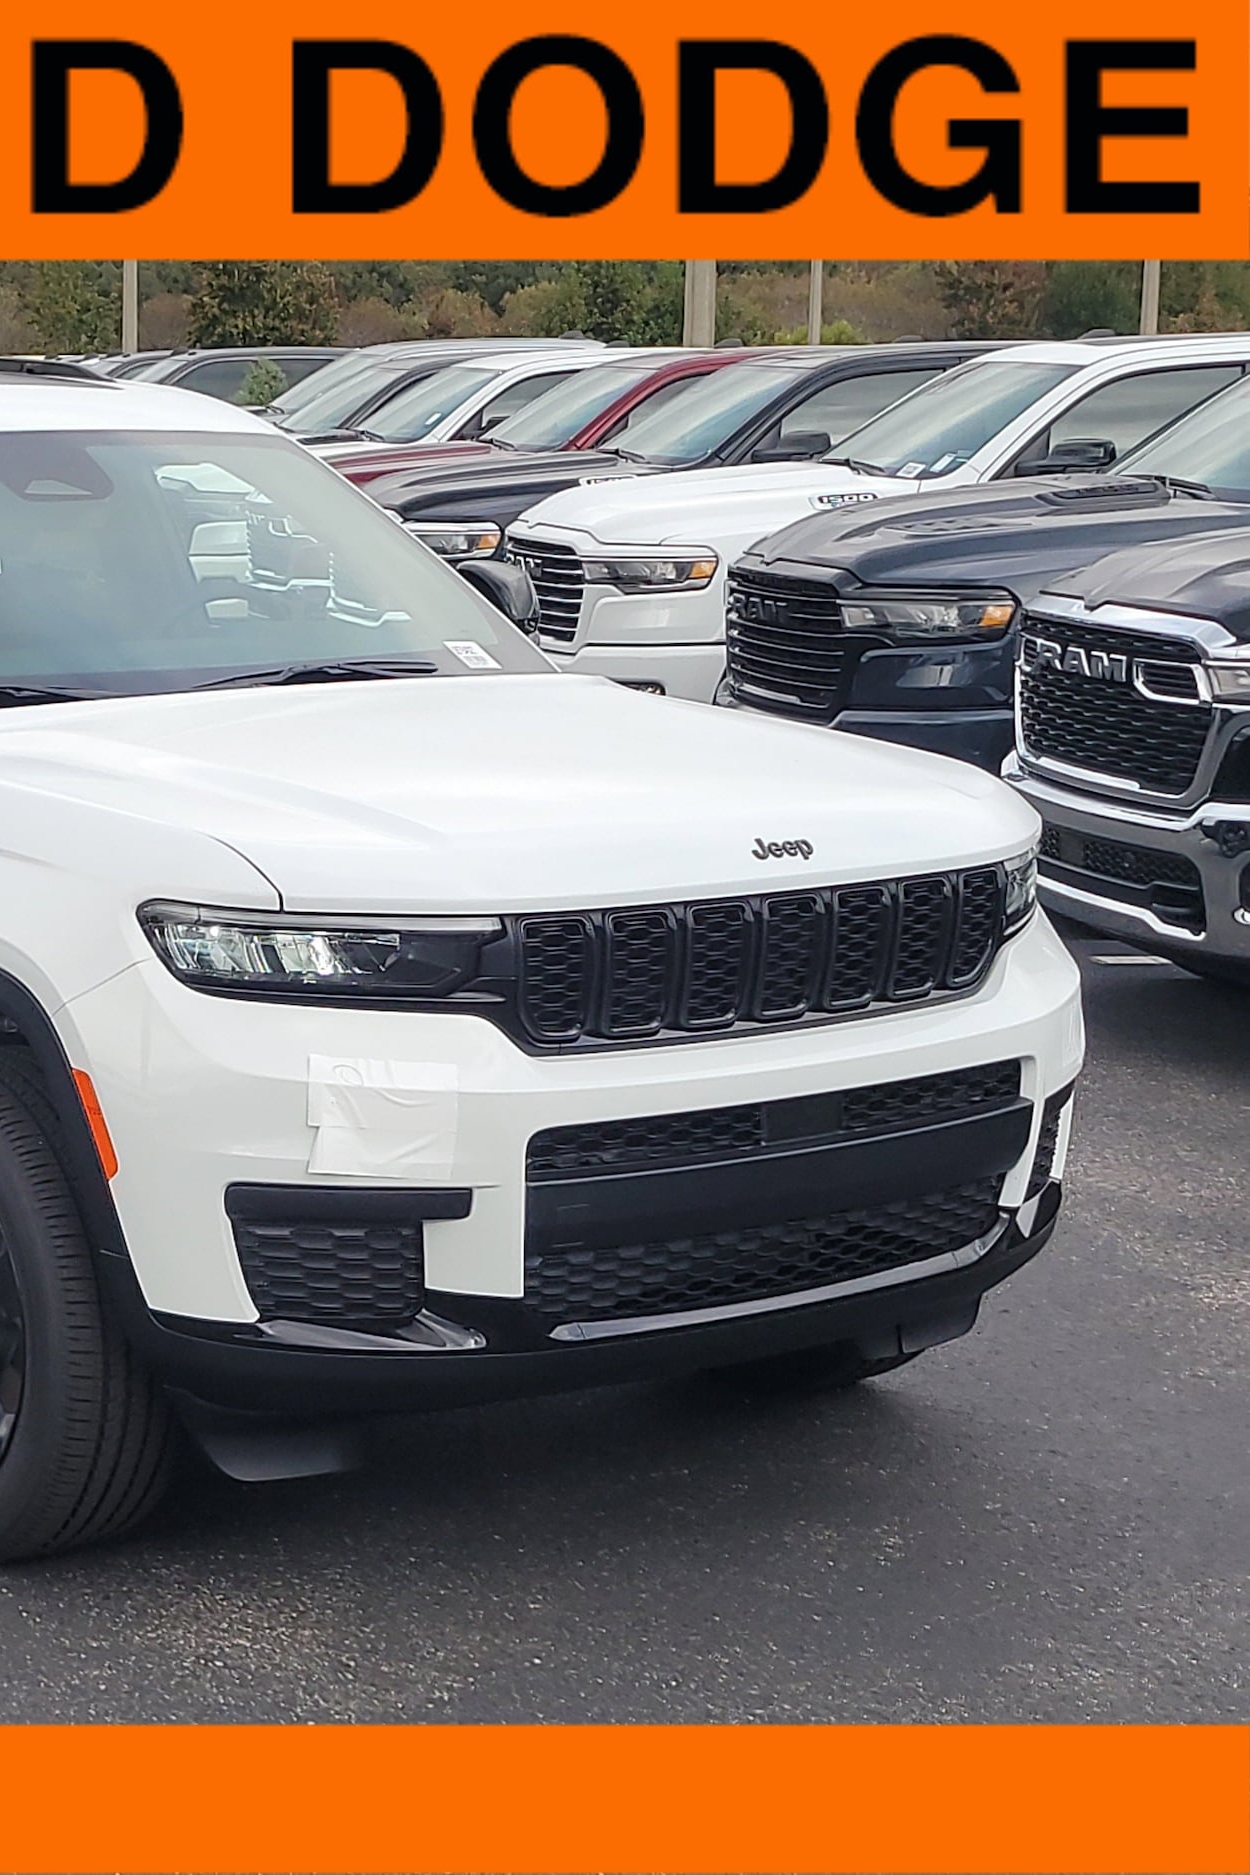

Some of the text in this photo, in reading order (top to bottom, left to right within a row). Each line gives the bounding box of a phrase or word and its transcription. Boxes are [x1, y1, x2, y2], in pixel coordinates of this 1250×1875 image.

[820, 492, 876, 503] 1500
[1031, 638, 1127, 683] RAM
[751, 838, 814, 860] Jeep
